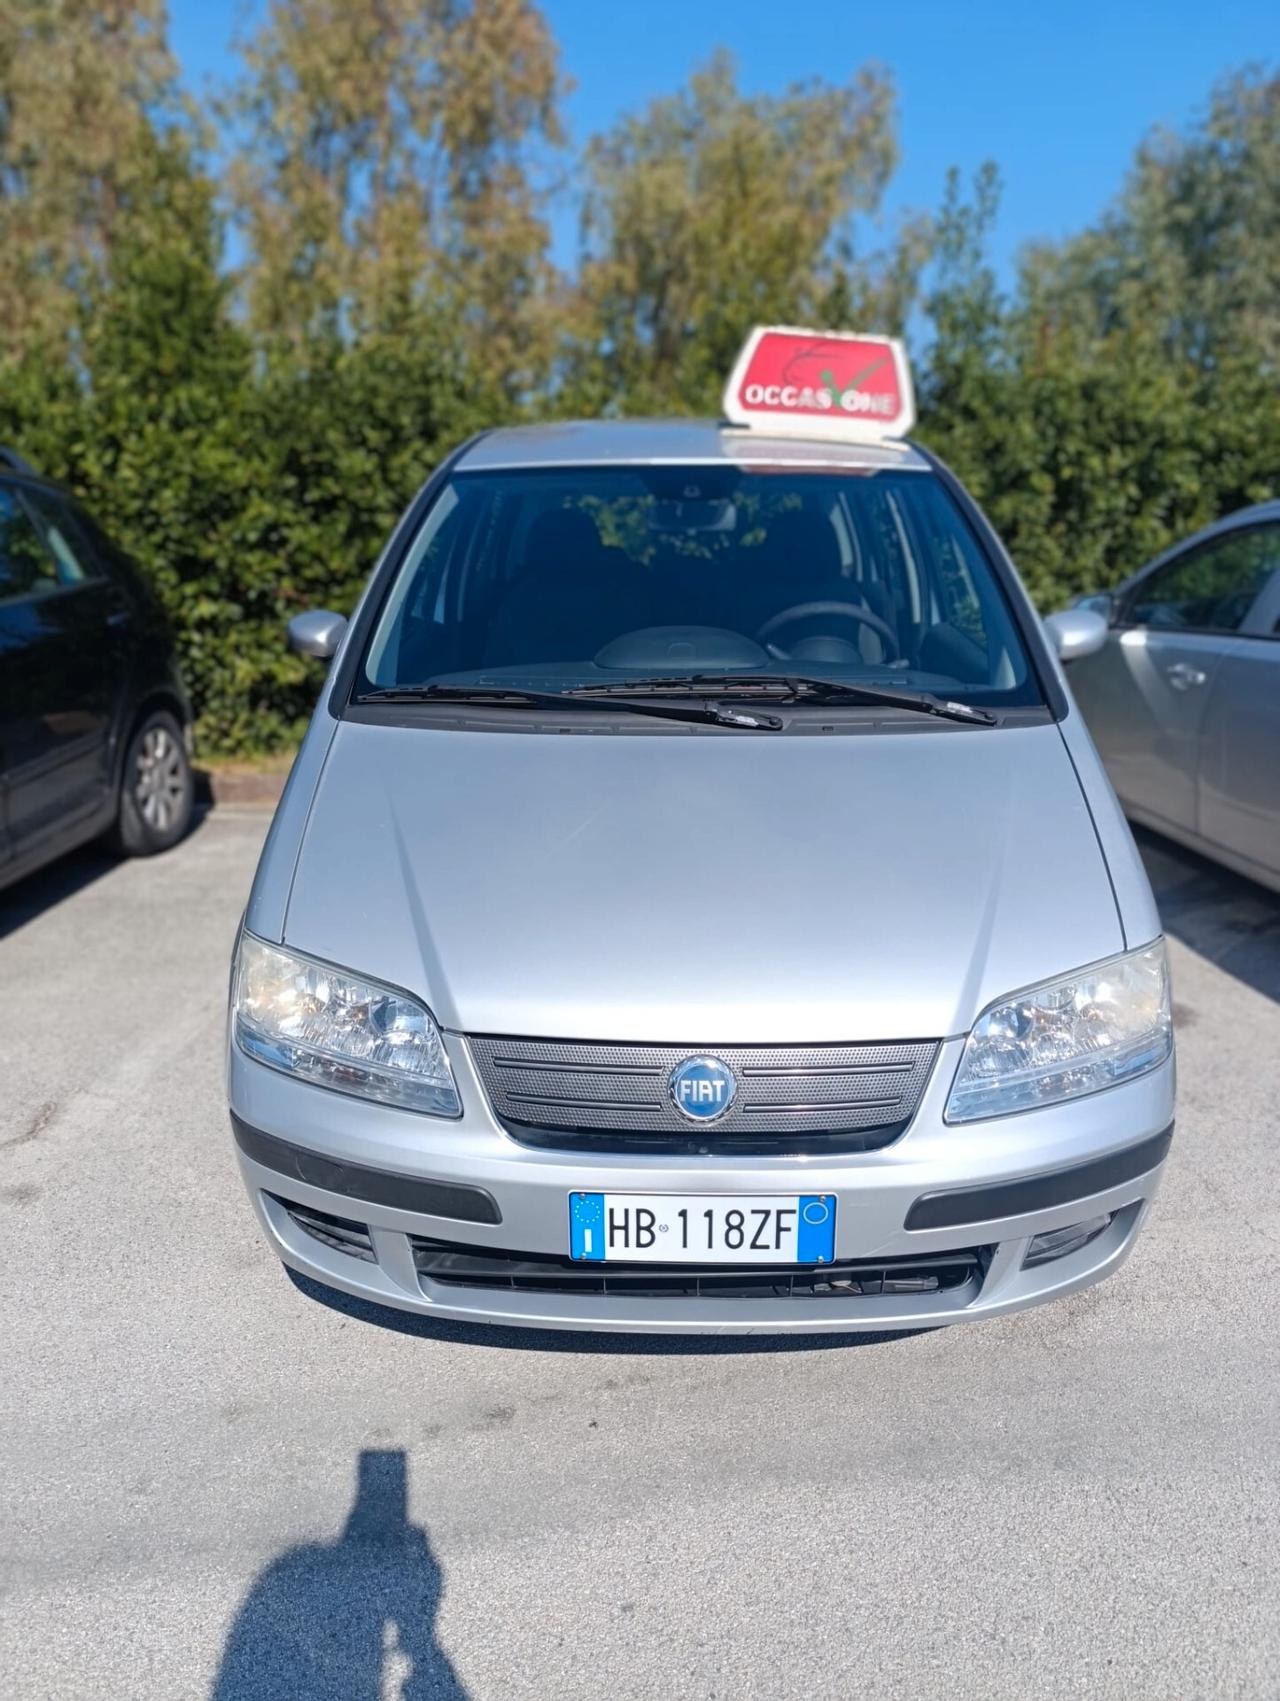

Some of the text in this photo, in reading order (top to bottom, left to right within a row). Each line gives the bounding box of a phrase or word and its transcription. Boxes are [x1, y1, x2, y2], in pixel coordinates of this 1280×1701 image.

[680, 1080, 725, 1102] FIAT
[608, 1207, 797, 1250] HB 118ZF
